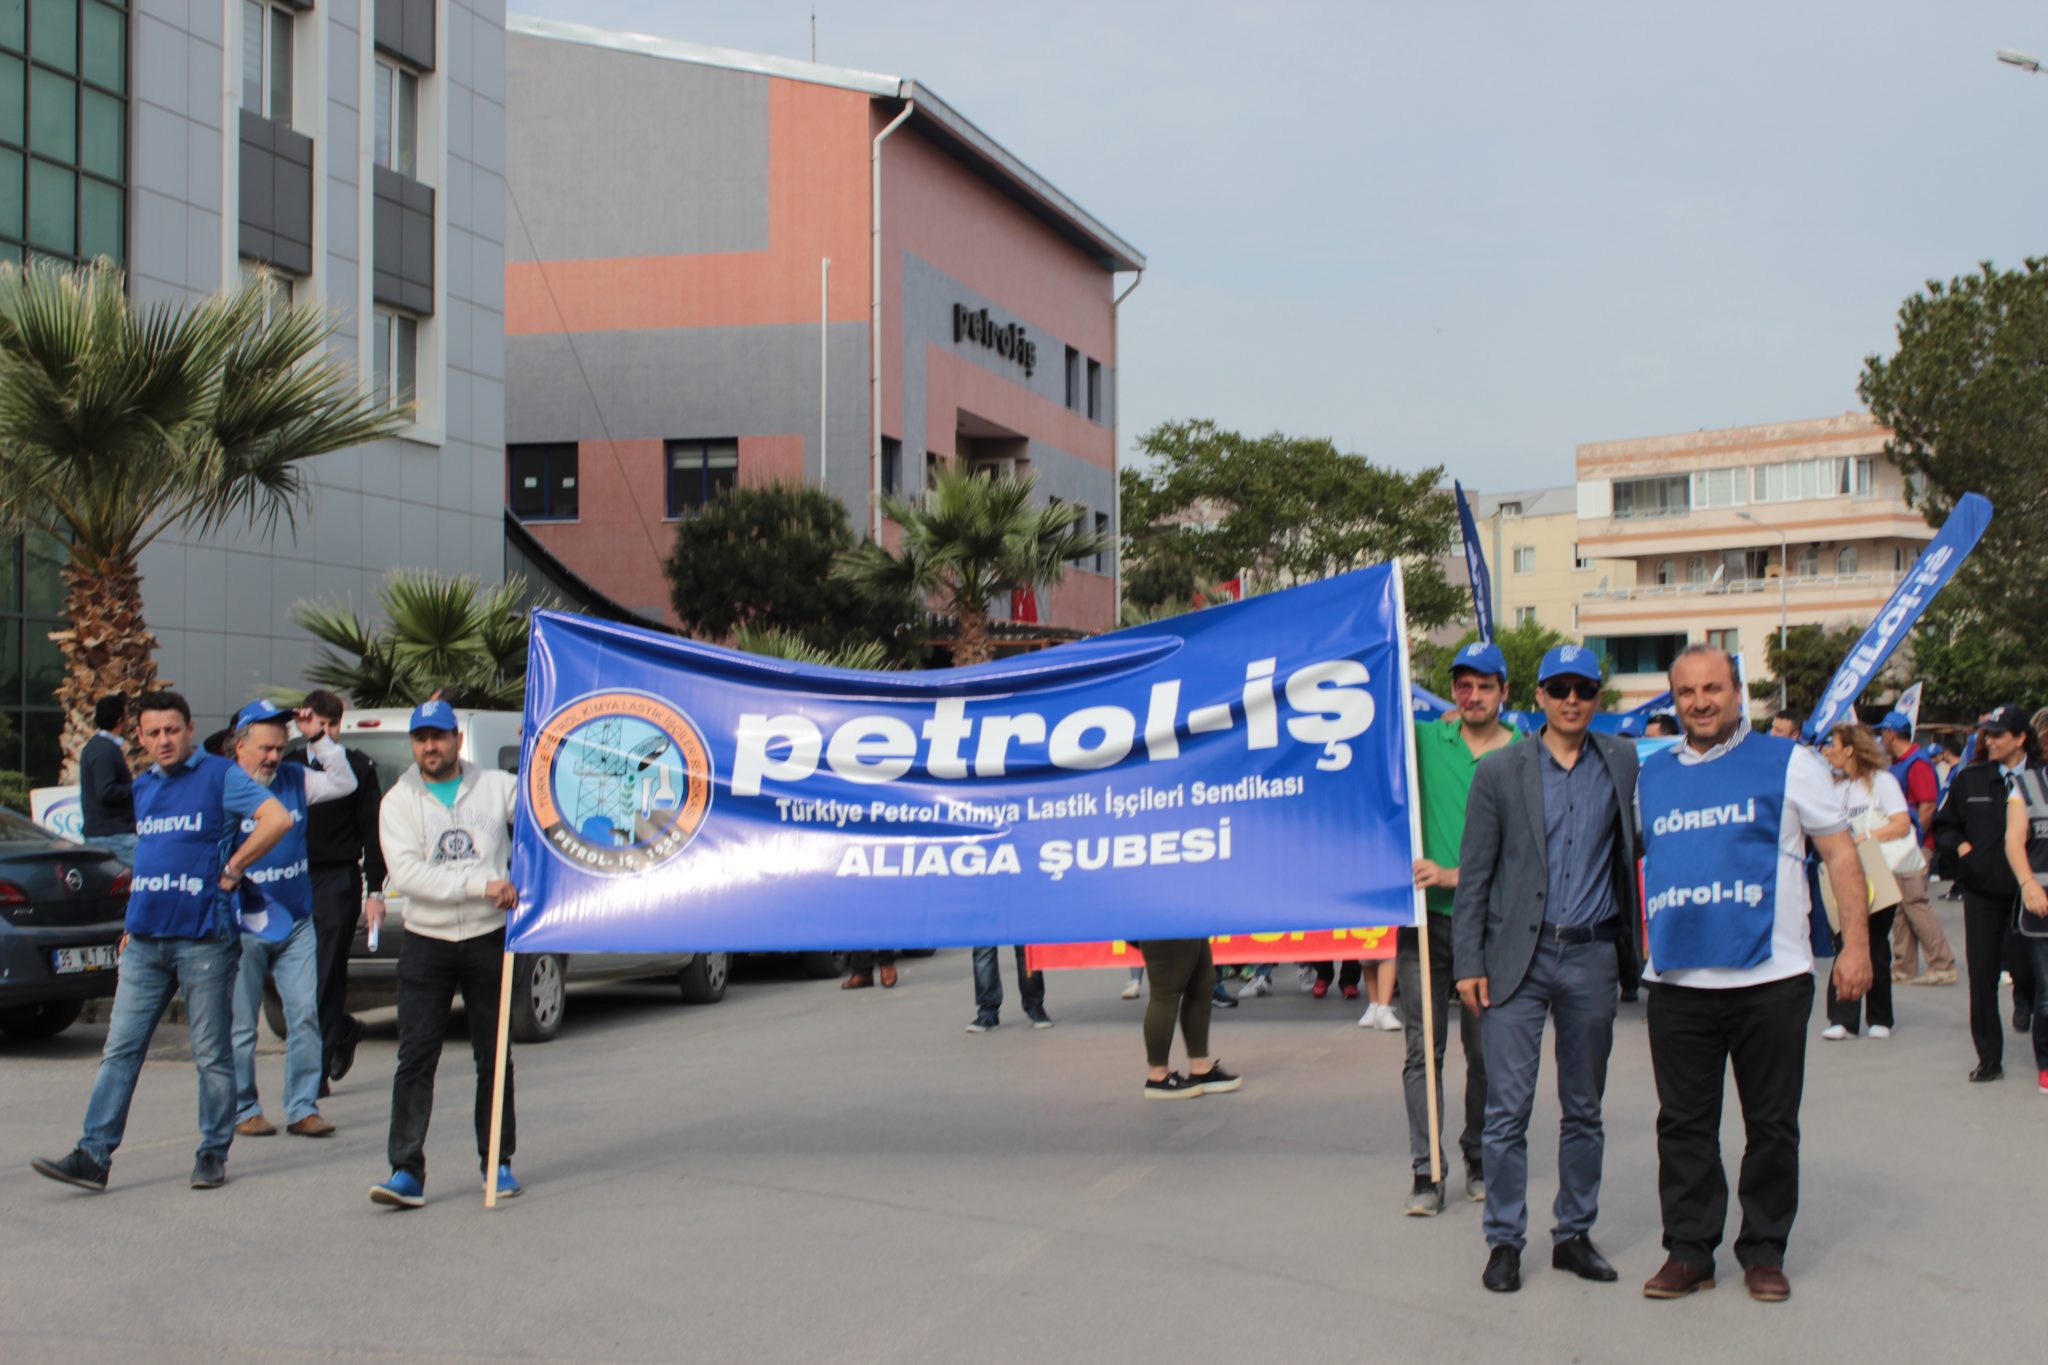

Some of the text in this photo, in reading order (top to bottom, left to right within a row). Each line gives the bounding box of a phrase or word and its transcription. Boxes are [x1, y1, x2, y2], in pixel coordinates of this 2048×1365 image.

[731, 657, 1375, 796] petrol-iş
[775, 775, 1304, 828] Türkiye Petrol Kimya Lastik İşçileri Sendikası
[1653, 797, 1755, 836] GÖREVLİ
[1038, 816, 1231, 881] ŞUBESİ
[1647, 880, 1764, 920] petrol-iş
